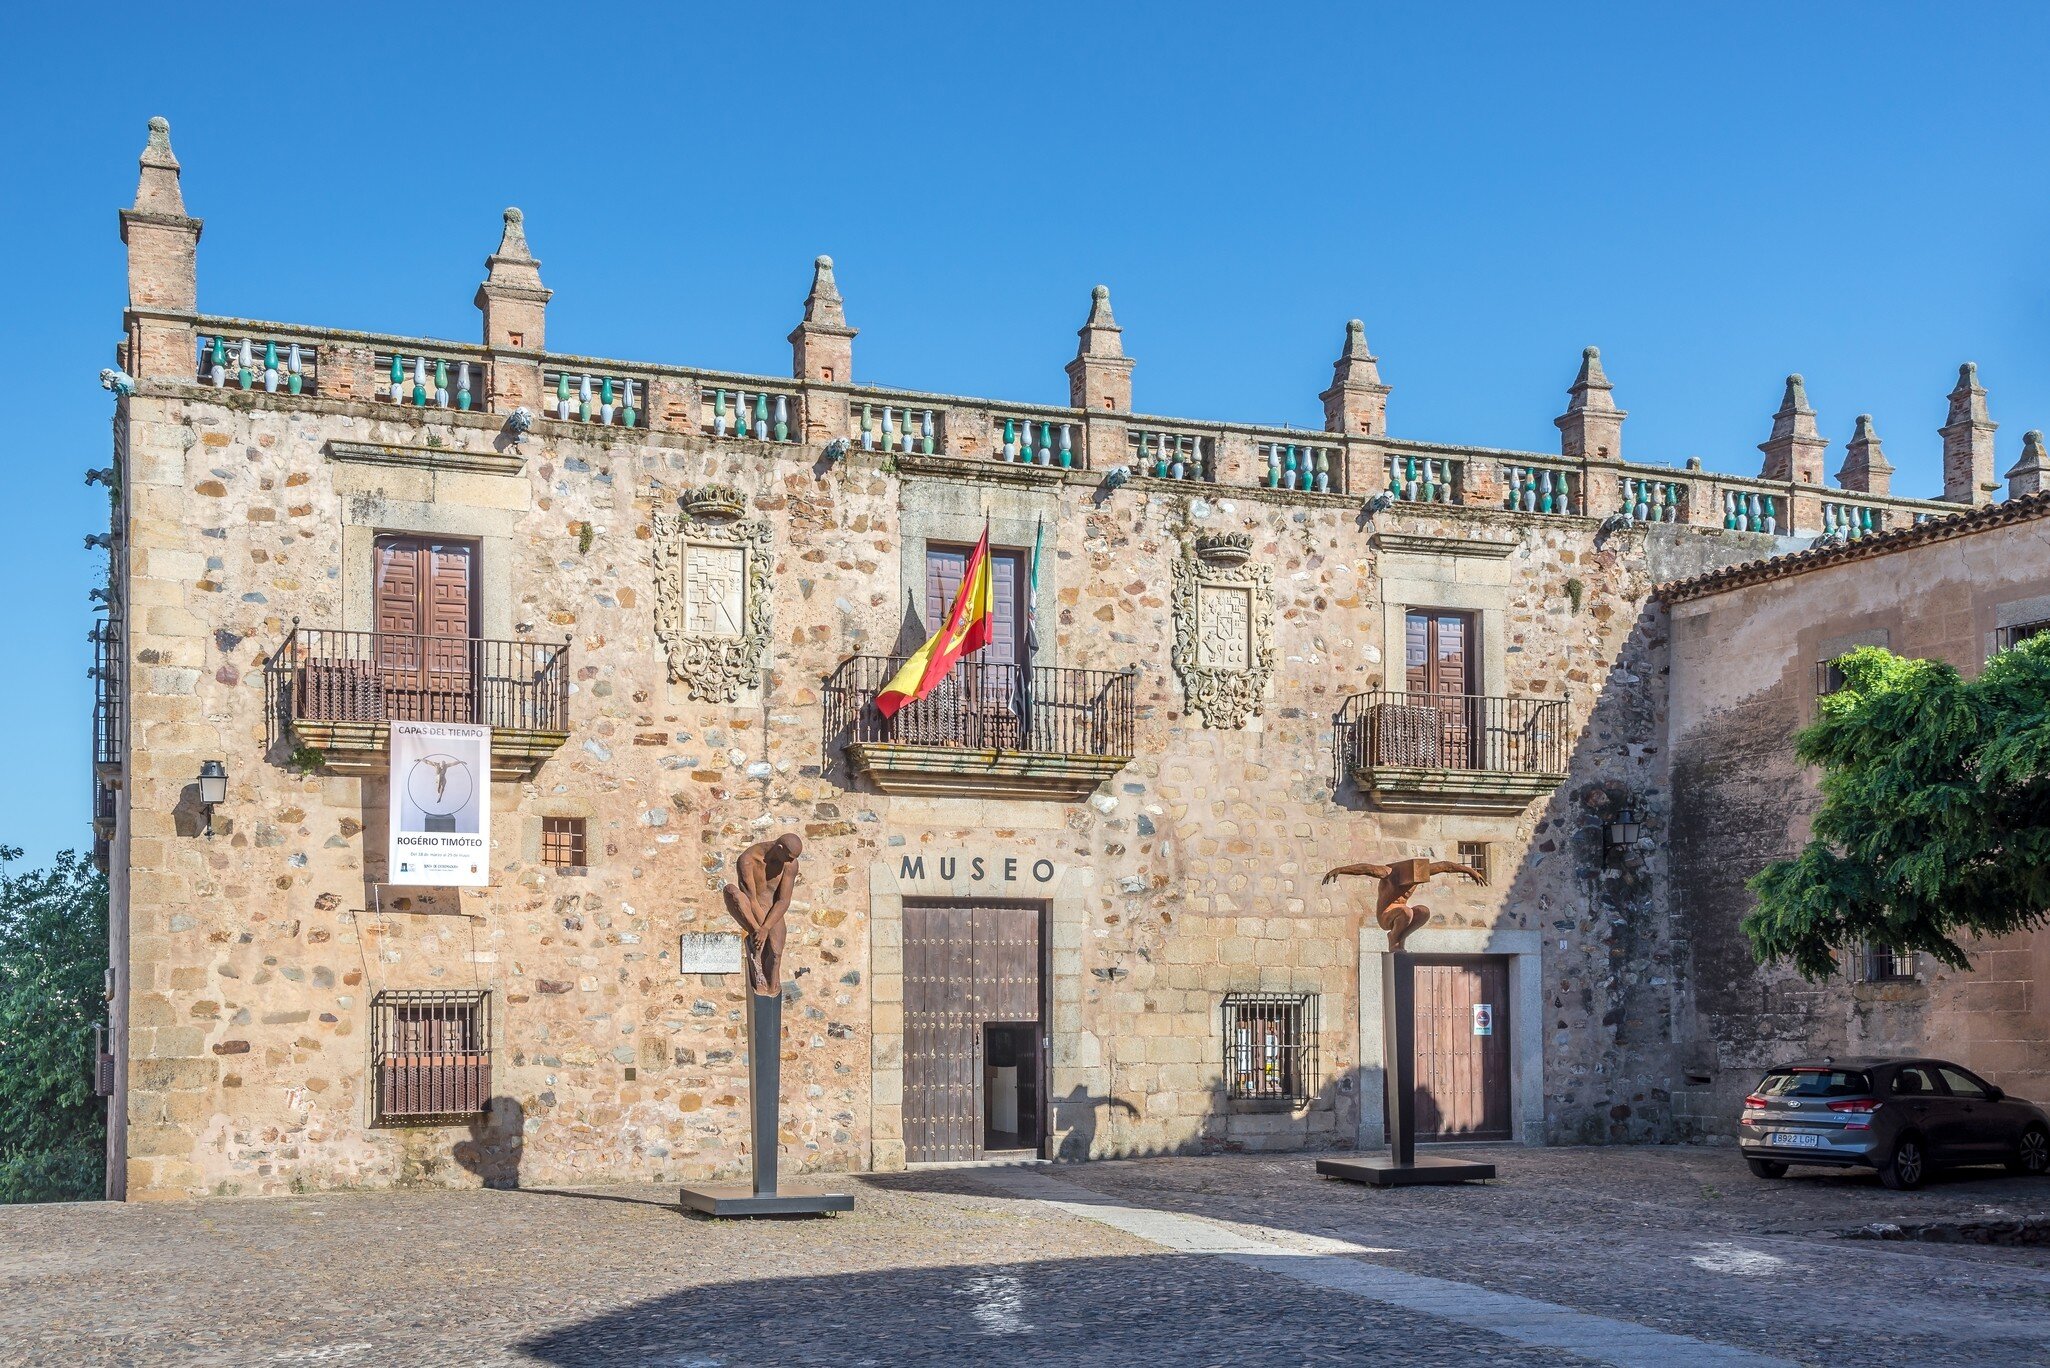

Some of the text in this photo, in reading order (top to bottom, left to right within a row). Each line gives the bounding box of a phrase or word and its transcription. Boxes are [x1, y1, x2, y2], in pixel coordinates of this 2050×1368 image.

[398, 726, 483, 738] CAPAS DEL TIEMPO
[397, 835, 483, 847] ROGÉRIO TIMÓTEO
[900, 855, 1055, 883] MUSEO
[1777, 1134, 1816, 1144] 8922 LGH
